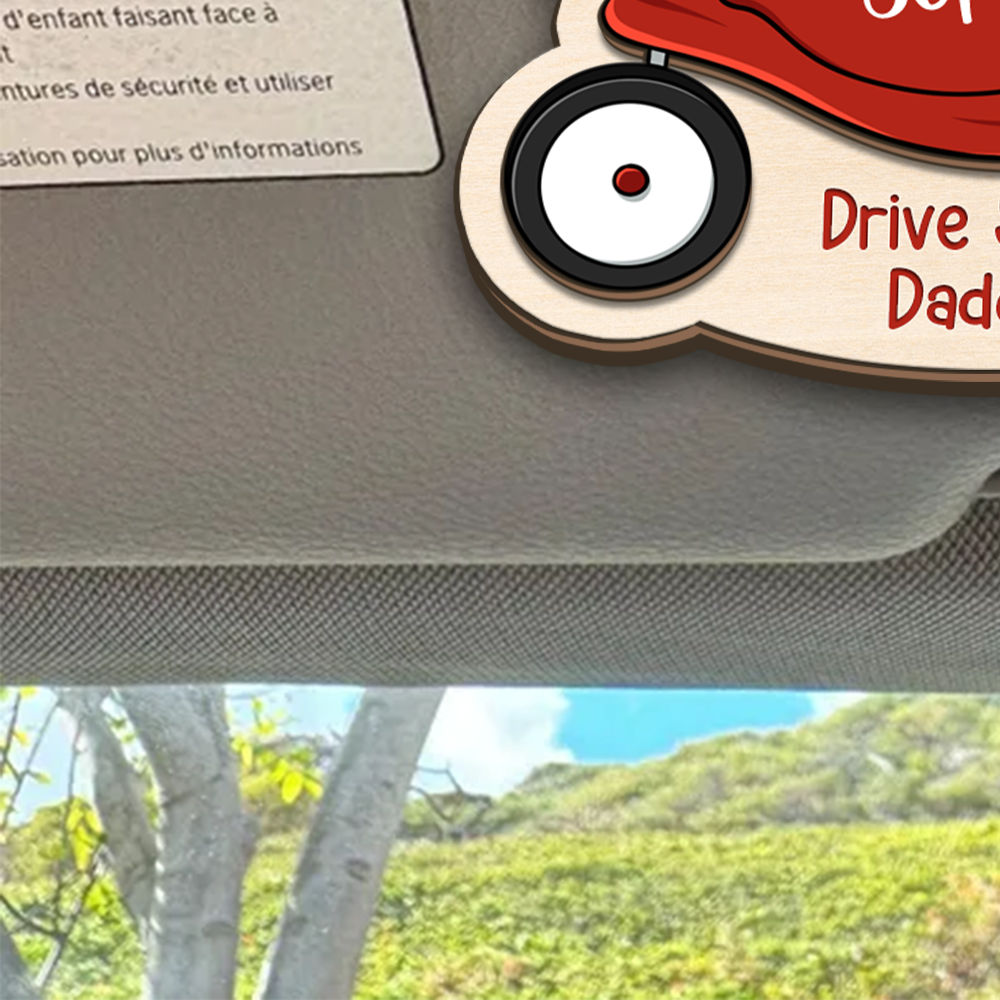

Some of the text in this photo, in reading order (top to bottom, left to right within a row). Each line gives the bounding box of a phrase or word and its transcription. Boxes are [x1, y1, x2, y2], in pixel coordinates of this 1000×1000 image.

[3, 1, 279, 31] d'enfant faisant face à
[0, 45, 14, 63] t
[0, 70, 335, 101] ntures de sécurité et utiliser
[72, 144, 127, 168] pour
[136, 140, 184, 164] plus
[190, 135, 363, 162] d'informations
[822, 188, 968, 250] Drive
